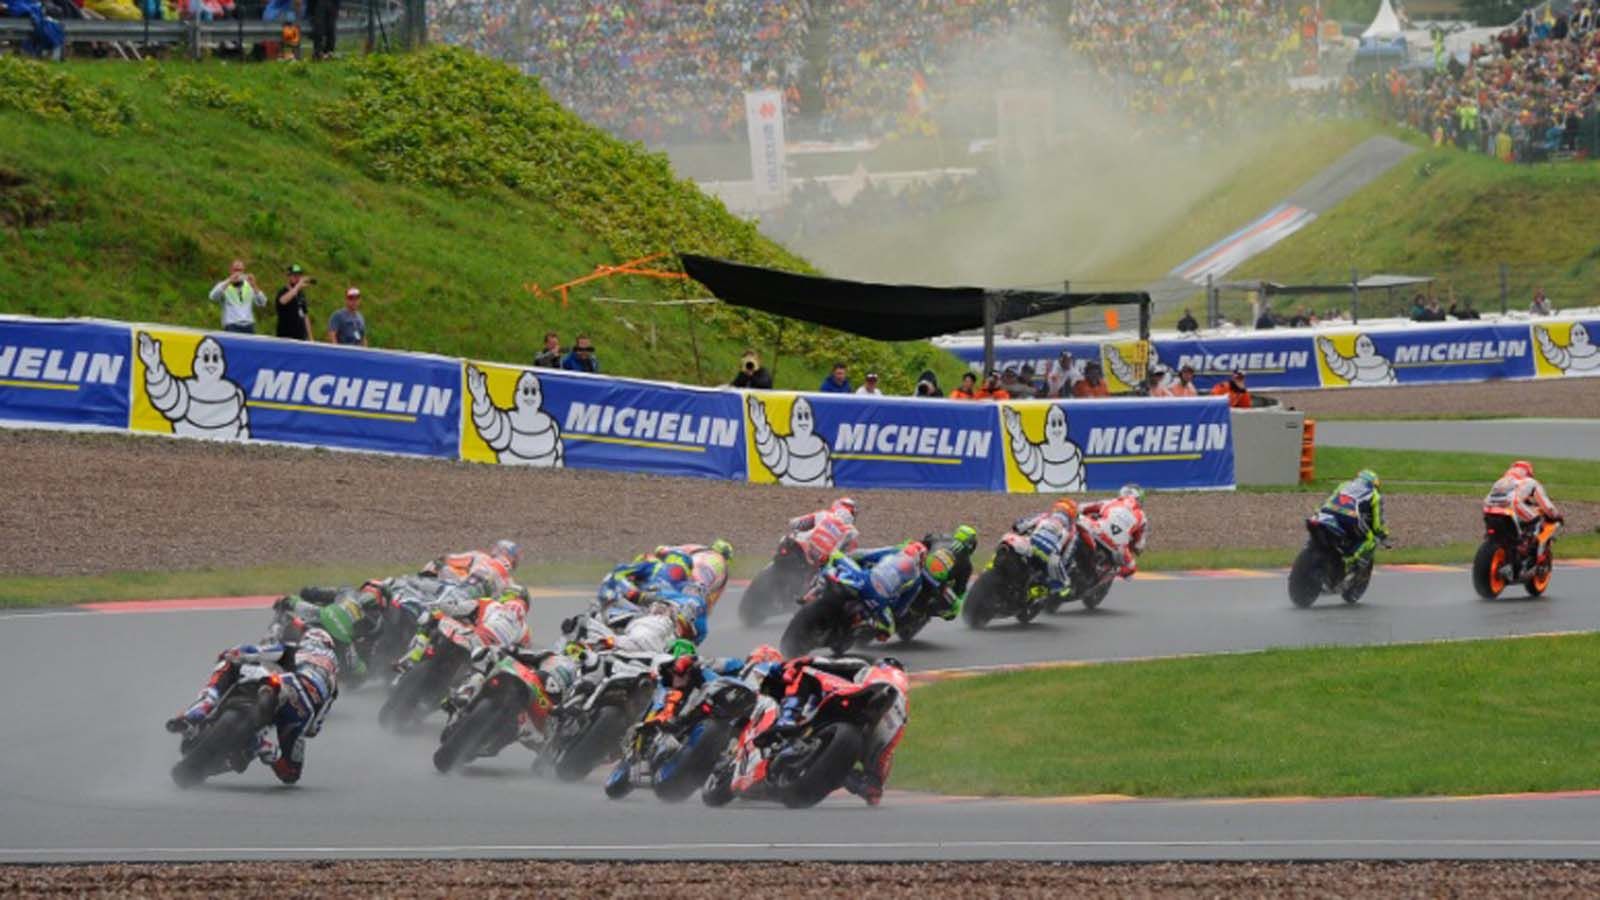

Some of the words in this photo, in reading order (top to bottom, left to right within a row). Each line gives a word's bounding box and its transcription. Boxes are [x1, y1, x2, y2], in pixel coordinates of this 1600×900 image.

[1177, 351, 1309, 371] MICHELIN
[1395, 340, 1527, 363] MICHELIN
[251, 369, 452, 416] MICHELIN
[566, 402, 738, 447] MICHELIN
[834, 423, 992, 459] MICHELIN
[1087, 424, 1227, 454] MICHELIN
